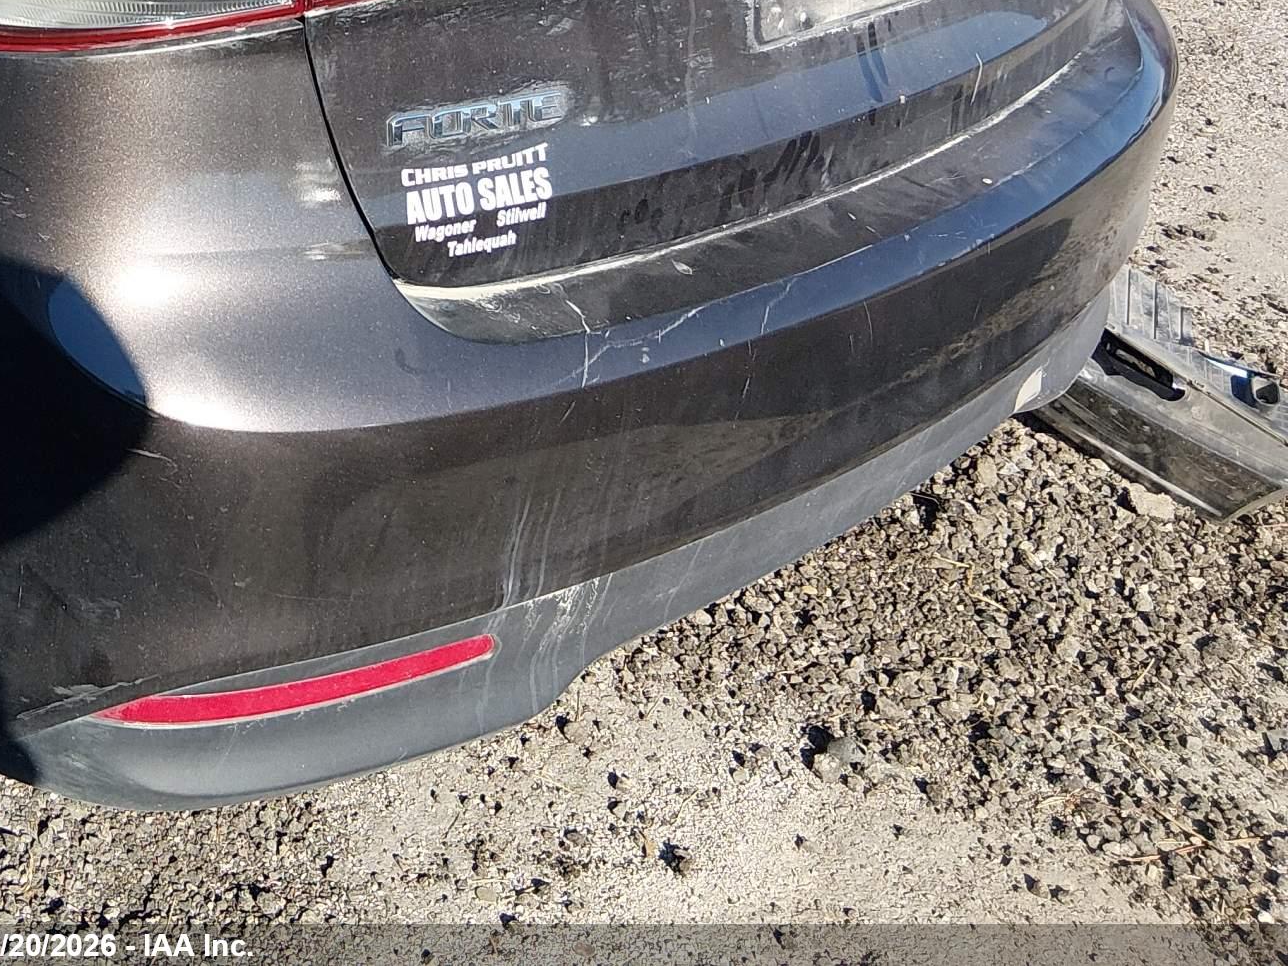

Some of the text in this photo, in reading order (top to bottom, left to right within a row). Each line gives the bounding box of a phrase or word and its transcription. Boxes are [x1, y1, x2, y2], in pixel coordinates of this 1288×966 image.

[386, 90, 566, 146] FORTE
[401, 143, 548, 187] CHRIS PRUITT
[406, 167, 552, 225] AUTO SALES
[415, 202, 546, 242] Wagoner Stilwell
[447, 229, 517, 257] Tahlequah
